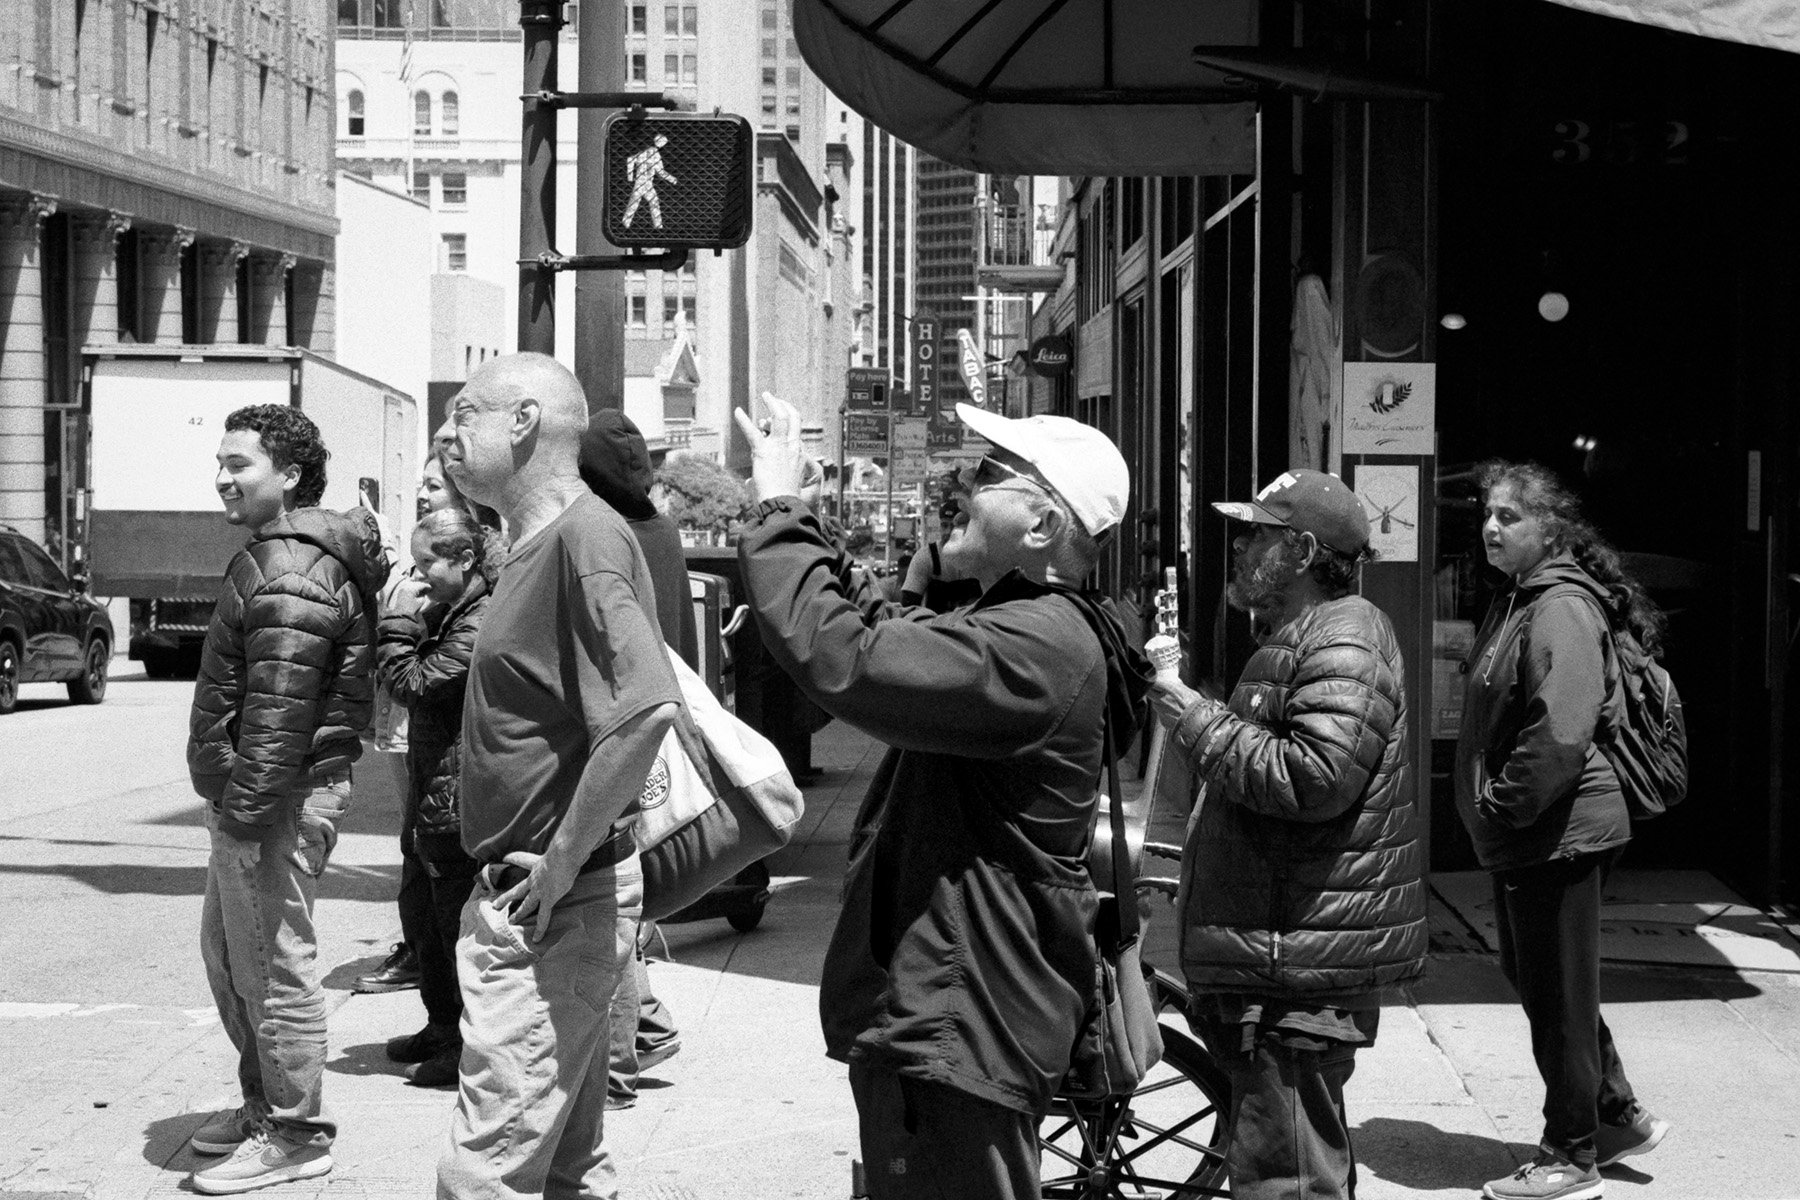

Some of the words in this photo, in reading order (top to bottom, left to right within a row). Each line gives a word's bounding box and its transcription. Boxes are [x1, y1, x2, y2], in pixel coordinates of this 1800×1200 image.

[1033, 347, 1068, 364] Leica
[850, 372, 867, 382] Pay
[867, 372, 888, 382] here
[958, 334, 985, 403] TABAC
[188, 416, 204, 426] 42
[927, 431, 957, 443] Arts
[643, 771, 667, 792] ADER
[641, 782, 667, 805] JOE'S
